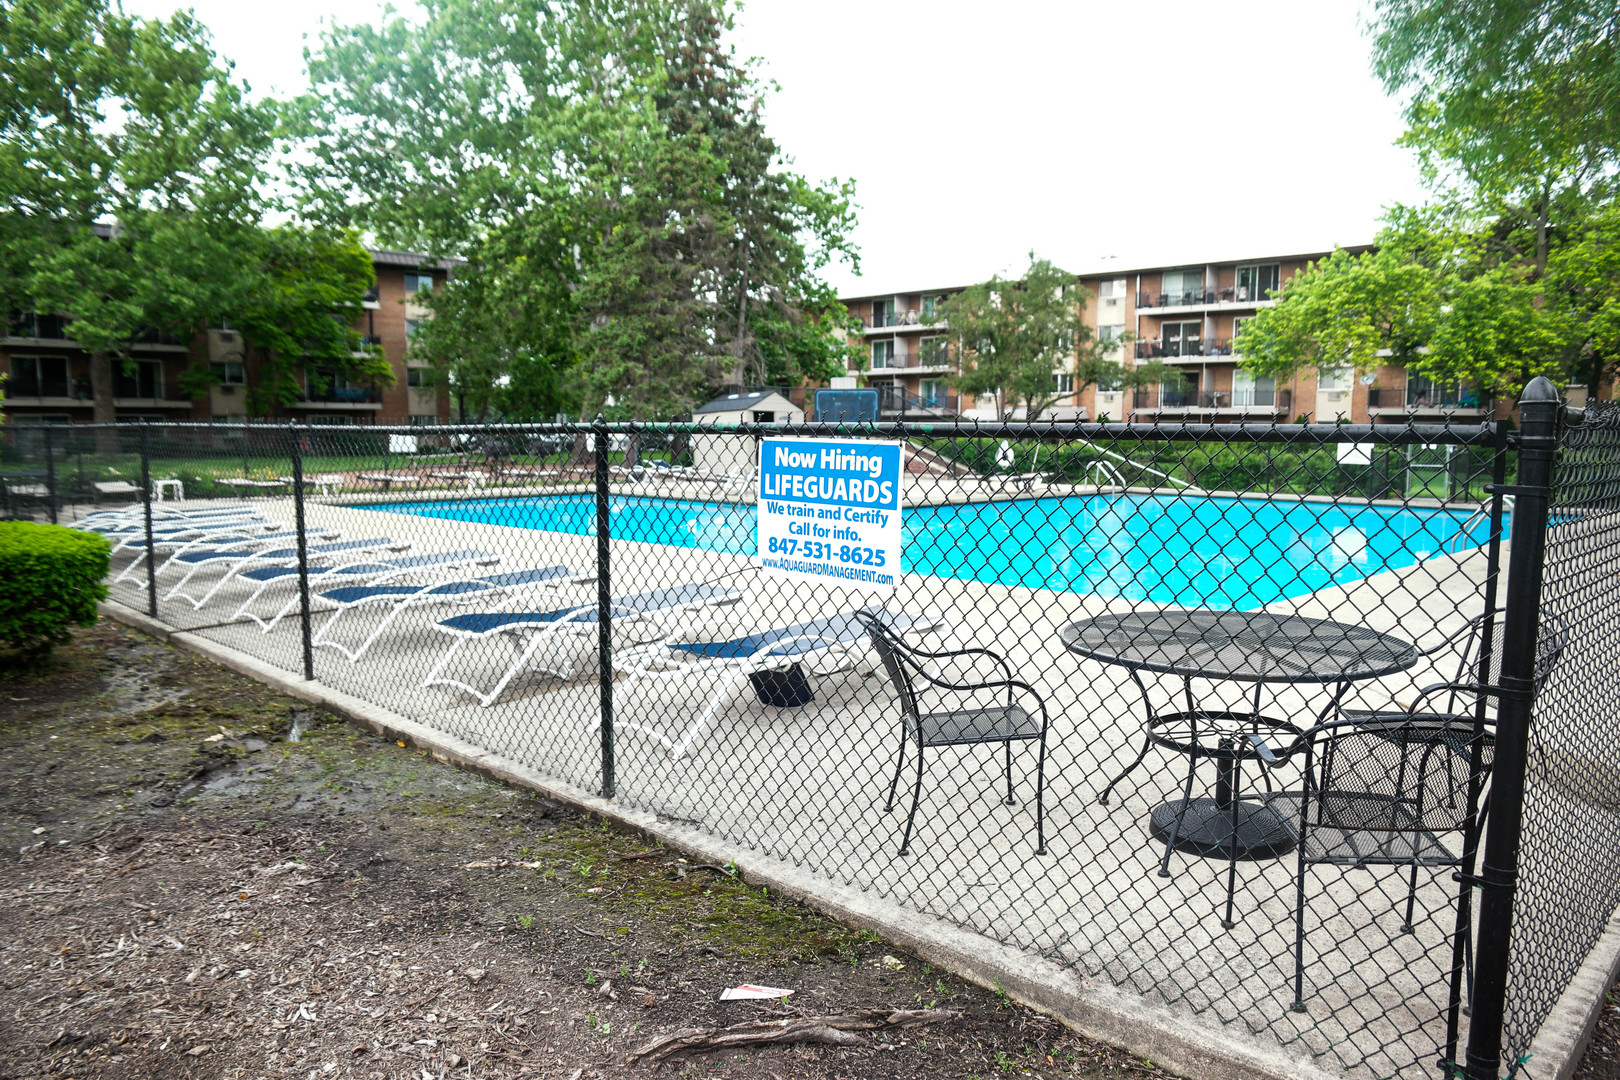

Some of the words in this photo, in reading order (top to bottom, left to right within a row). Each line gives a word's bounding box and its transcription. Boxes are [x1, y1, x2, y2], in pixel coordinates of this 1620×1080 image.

[775, 447, 816, 468] Now
[821, 449, 882, 478] Hiring
[765, 474, 892, 504] LIFEGUARDS
[767, 501, 784, 515] We
[787, 504, 814, 517] train
[818, 507, 840, 520] and
[844, 508, 888, 528] Certify
[789, 522, 810, 535] Call
[813, 523, 830, 538] for
[834, 526, 861, 541] info.
[769, 537, 885, 567] 847-531-8625
